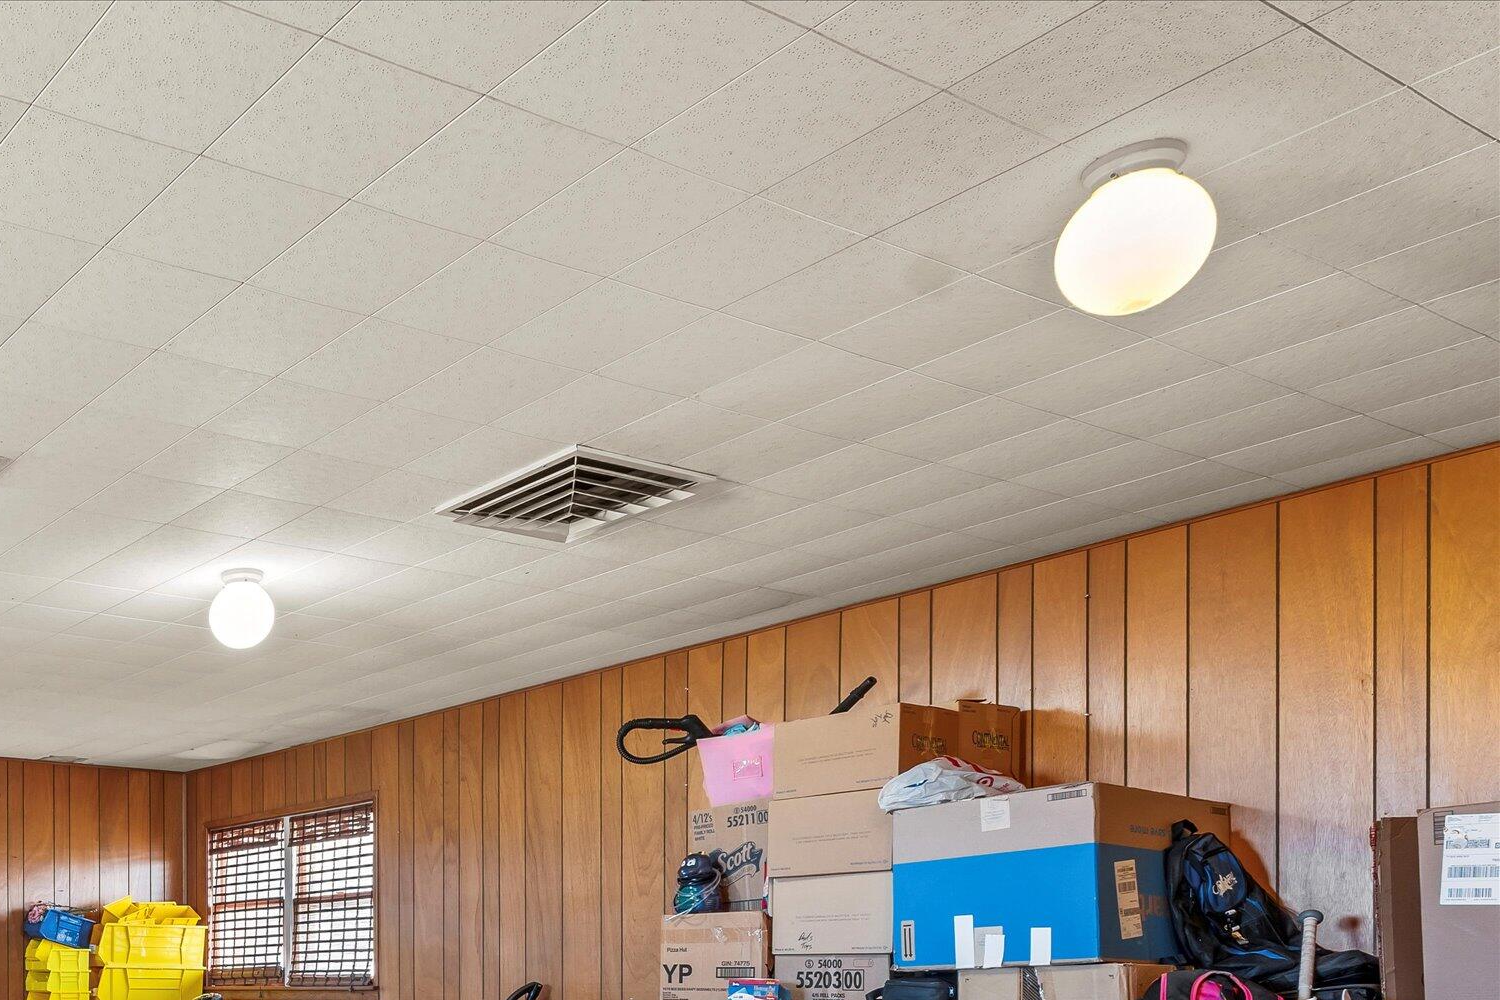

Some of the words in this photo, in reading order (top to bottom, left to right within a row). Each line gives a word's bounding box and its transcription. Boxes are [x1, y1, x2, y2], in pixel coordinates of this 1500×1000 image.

[718, 842, 754, 874] Scott
[663, 964, 692, 983] YP
[818, 959, 842, 969] 54000
